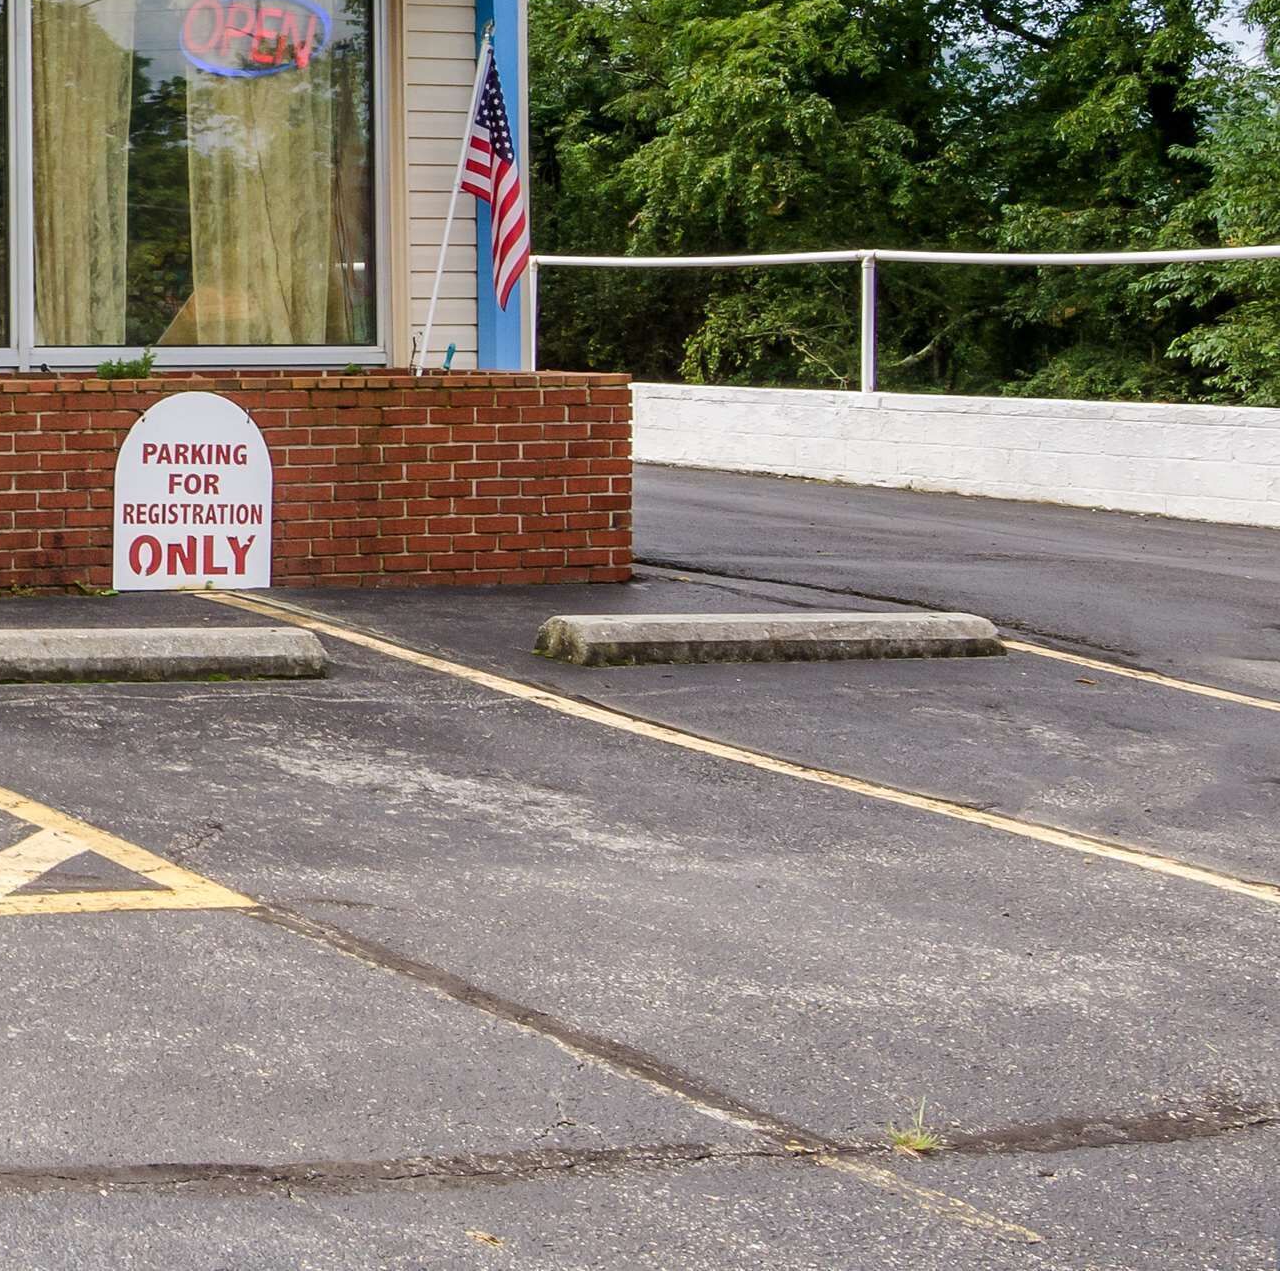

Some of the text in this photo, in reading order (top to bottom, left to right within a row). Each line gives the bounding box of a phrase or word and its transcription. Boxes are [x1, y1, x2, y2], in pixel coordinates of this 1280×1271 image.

[142, 443, 247, 465] PARKING
[168, 473, 219, 495] FOR
[122, 503, 263, 525] REGISTRATION
[128, 534, 256, 577] ONLY
